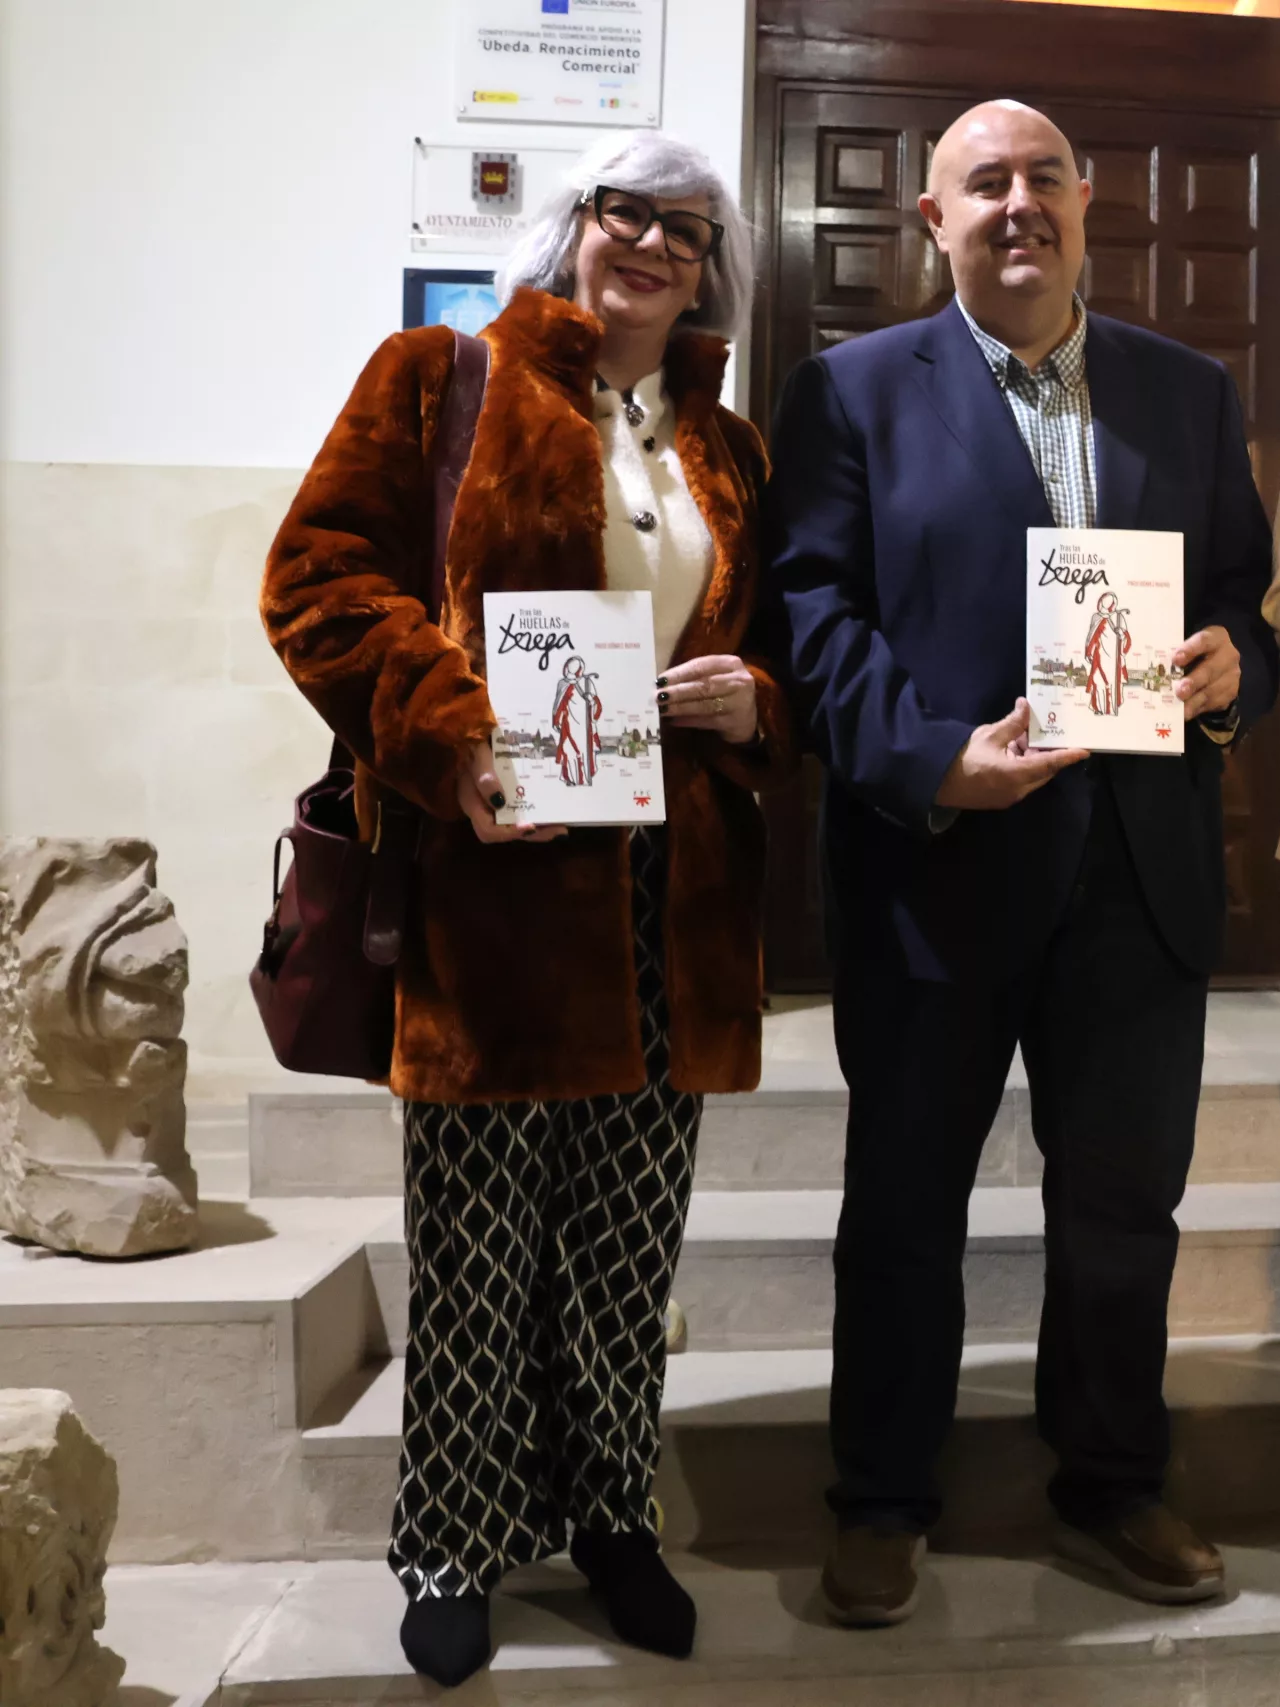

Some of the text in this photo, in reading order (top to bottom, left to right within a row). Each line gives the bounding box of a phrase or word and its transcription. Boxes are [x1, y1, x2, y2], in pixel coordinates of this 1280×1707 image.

[539, 42, 641, 59] Renacimiento
[425, 215, 513, 228] AYUNTAMIENTO
[1059, 553, 1098, 565] HUELLAS
[519, 617, 562, 629] HUELLAS
